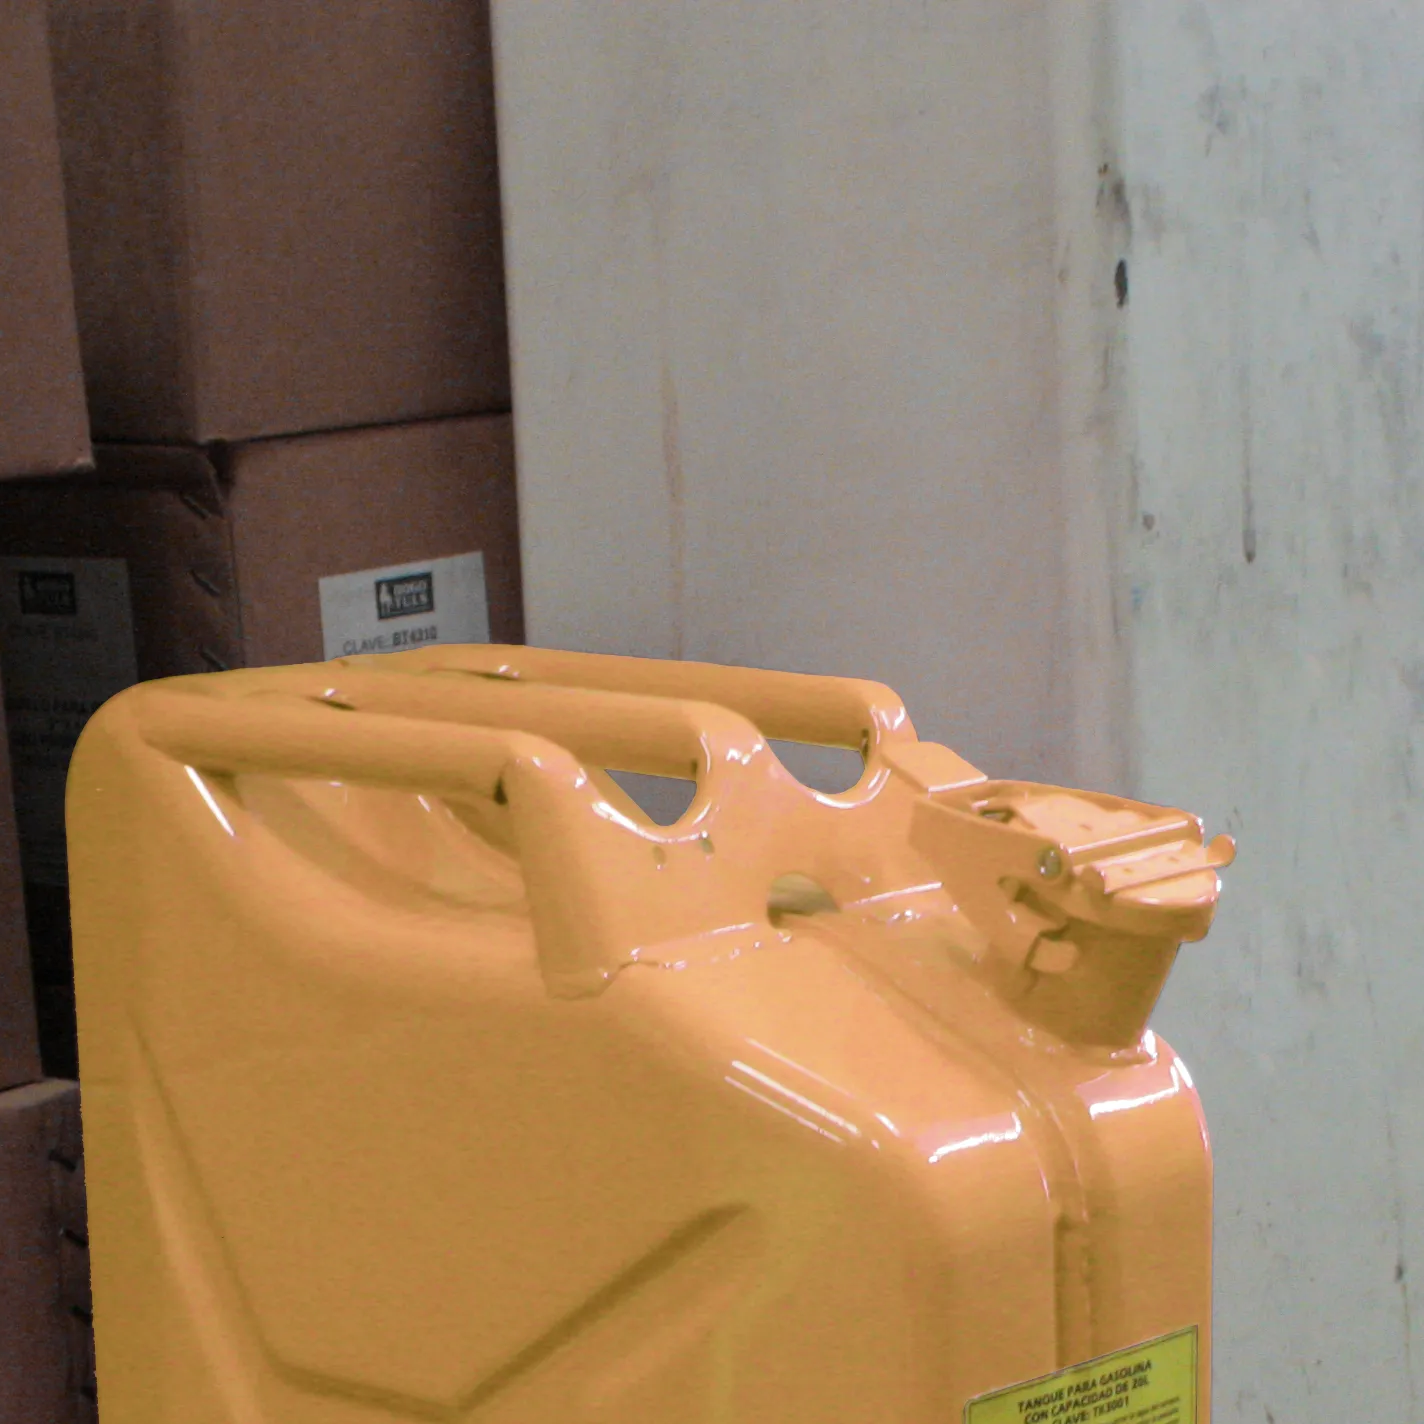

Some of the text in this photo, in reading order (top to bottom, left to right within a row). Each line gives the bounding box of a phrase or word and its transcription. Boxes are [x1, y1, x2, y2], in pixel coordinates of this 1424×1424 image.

[1017, 1359, 1153, 1413] TANQUE PARA GASOLINA
[1050, 1387, 1113, 1418] CAPACIDAD
[1114, 1381, 1129, 1396] DE
